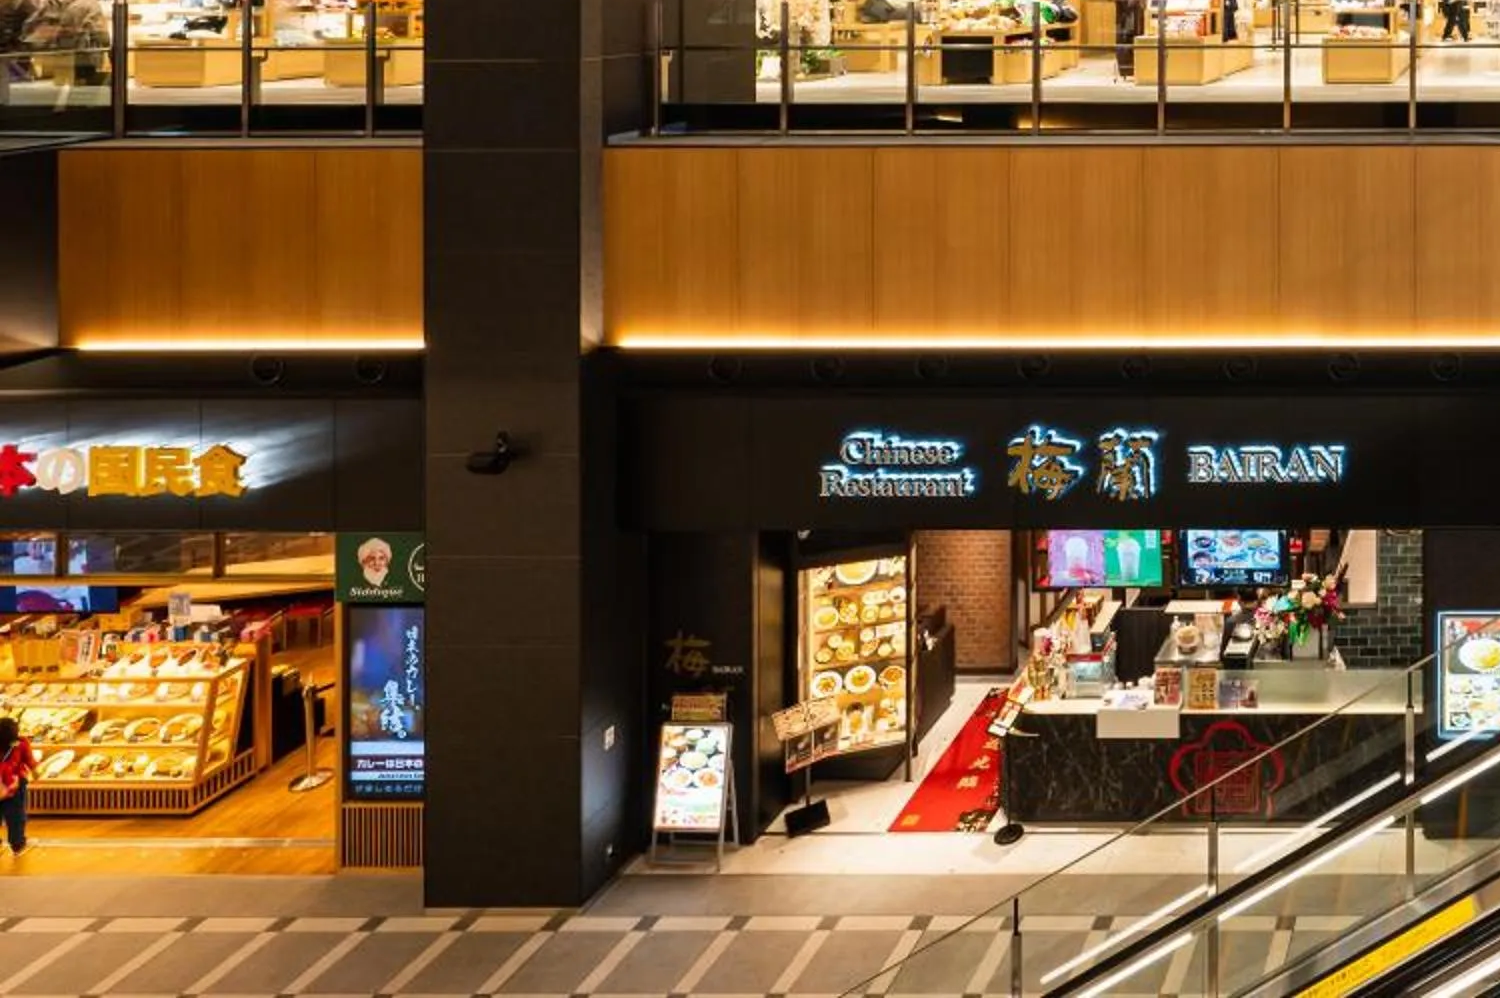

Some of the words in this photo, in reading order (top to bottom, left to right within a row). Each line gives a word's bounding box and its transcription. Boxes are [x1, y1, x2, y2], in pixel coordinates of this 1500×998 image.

[839, 431, 960, 467] Chinese
[1187, 445, 1346, 484] BAIRAN
[819, 465, 975, 498] Restaurant
